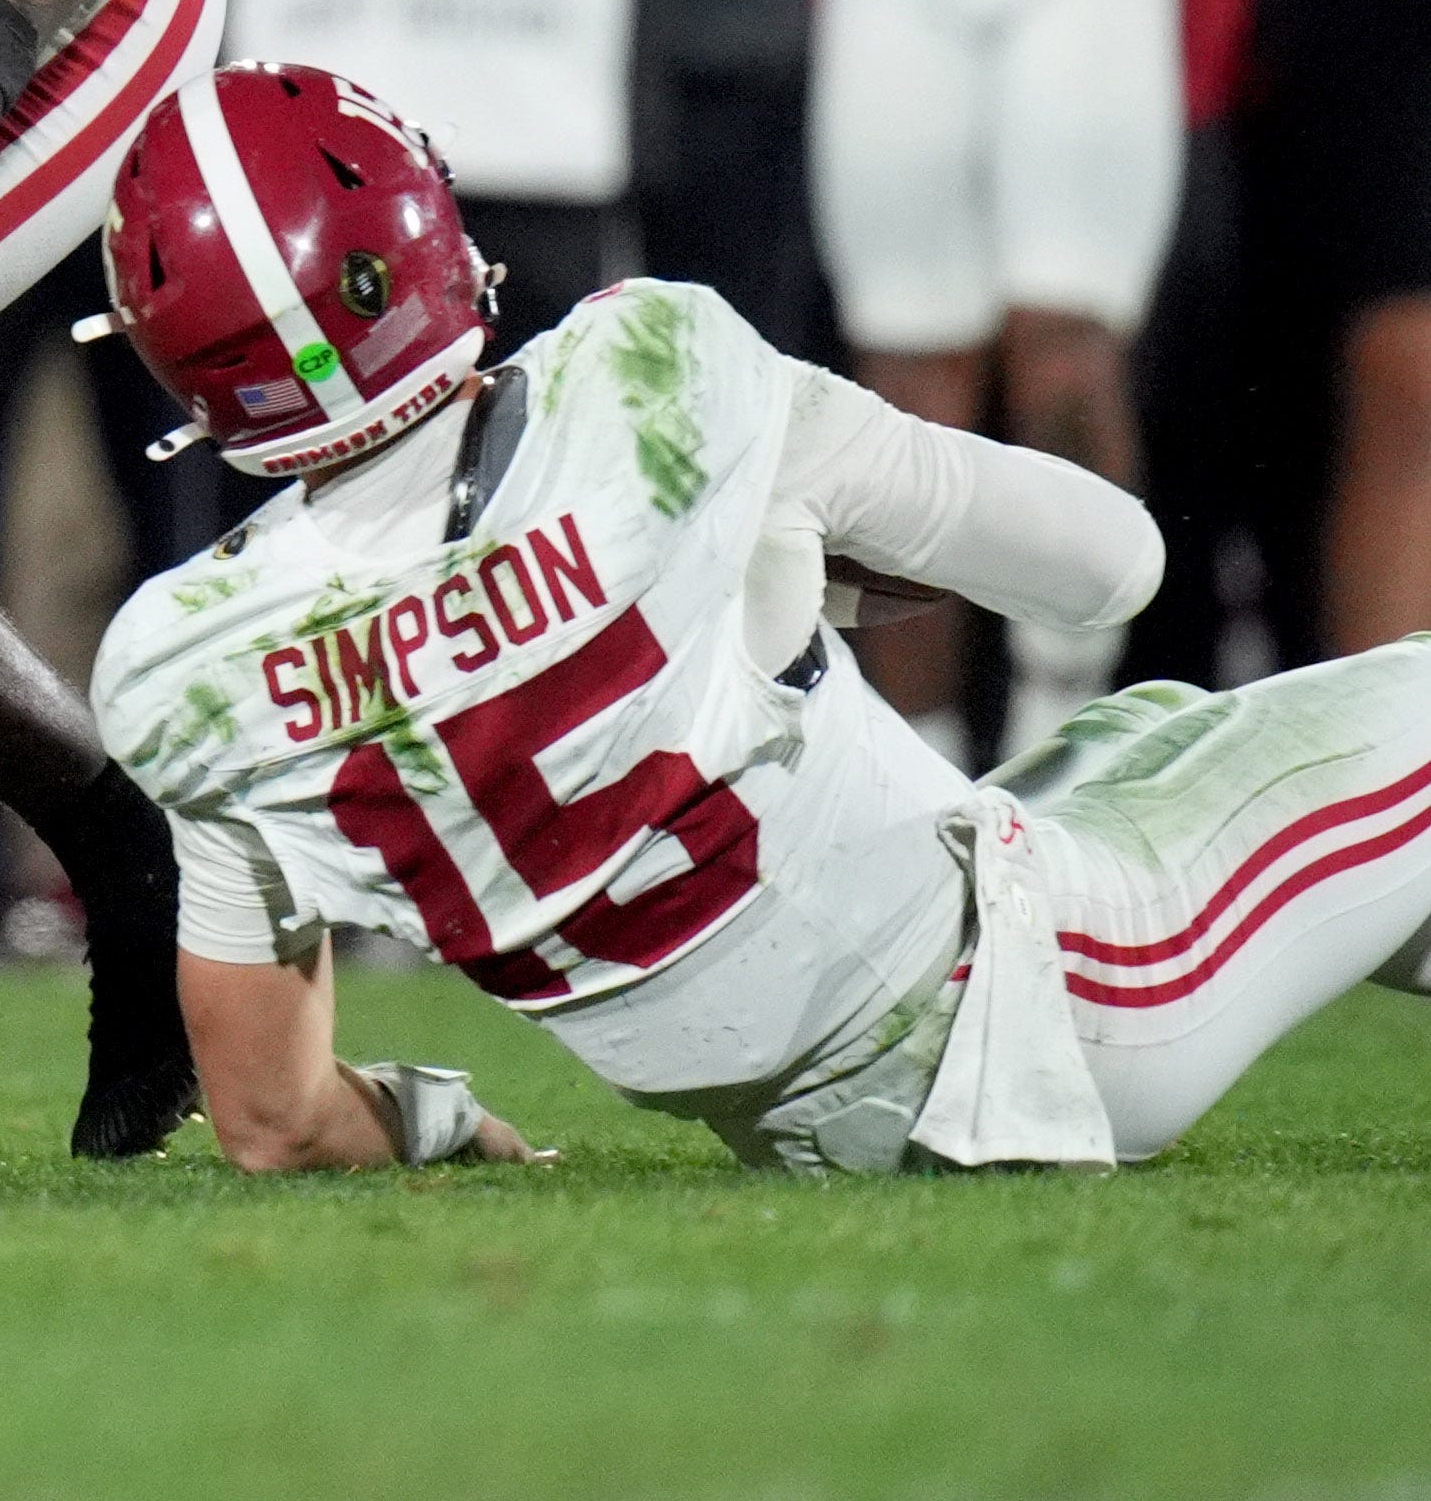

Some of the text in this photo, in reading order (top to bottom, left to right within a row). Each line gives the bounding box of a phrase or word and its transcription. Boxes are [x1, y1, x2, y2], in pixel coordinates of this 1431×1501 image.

[262, 372, 453, 474] CRIMSON TIDE
[298, 349, 333, 374] C2P
[262, 513, 607, 742] SIMPSON
[327, 603, 759, 1001] 15
